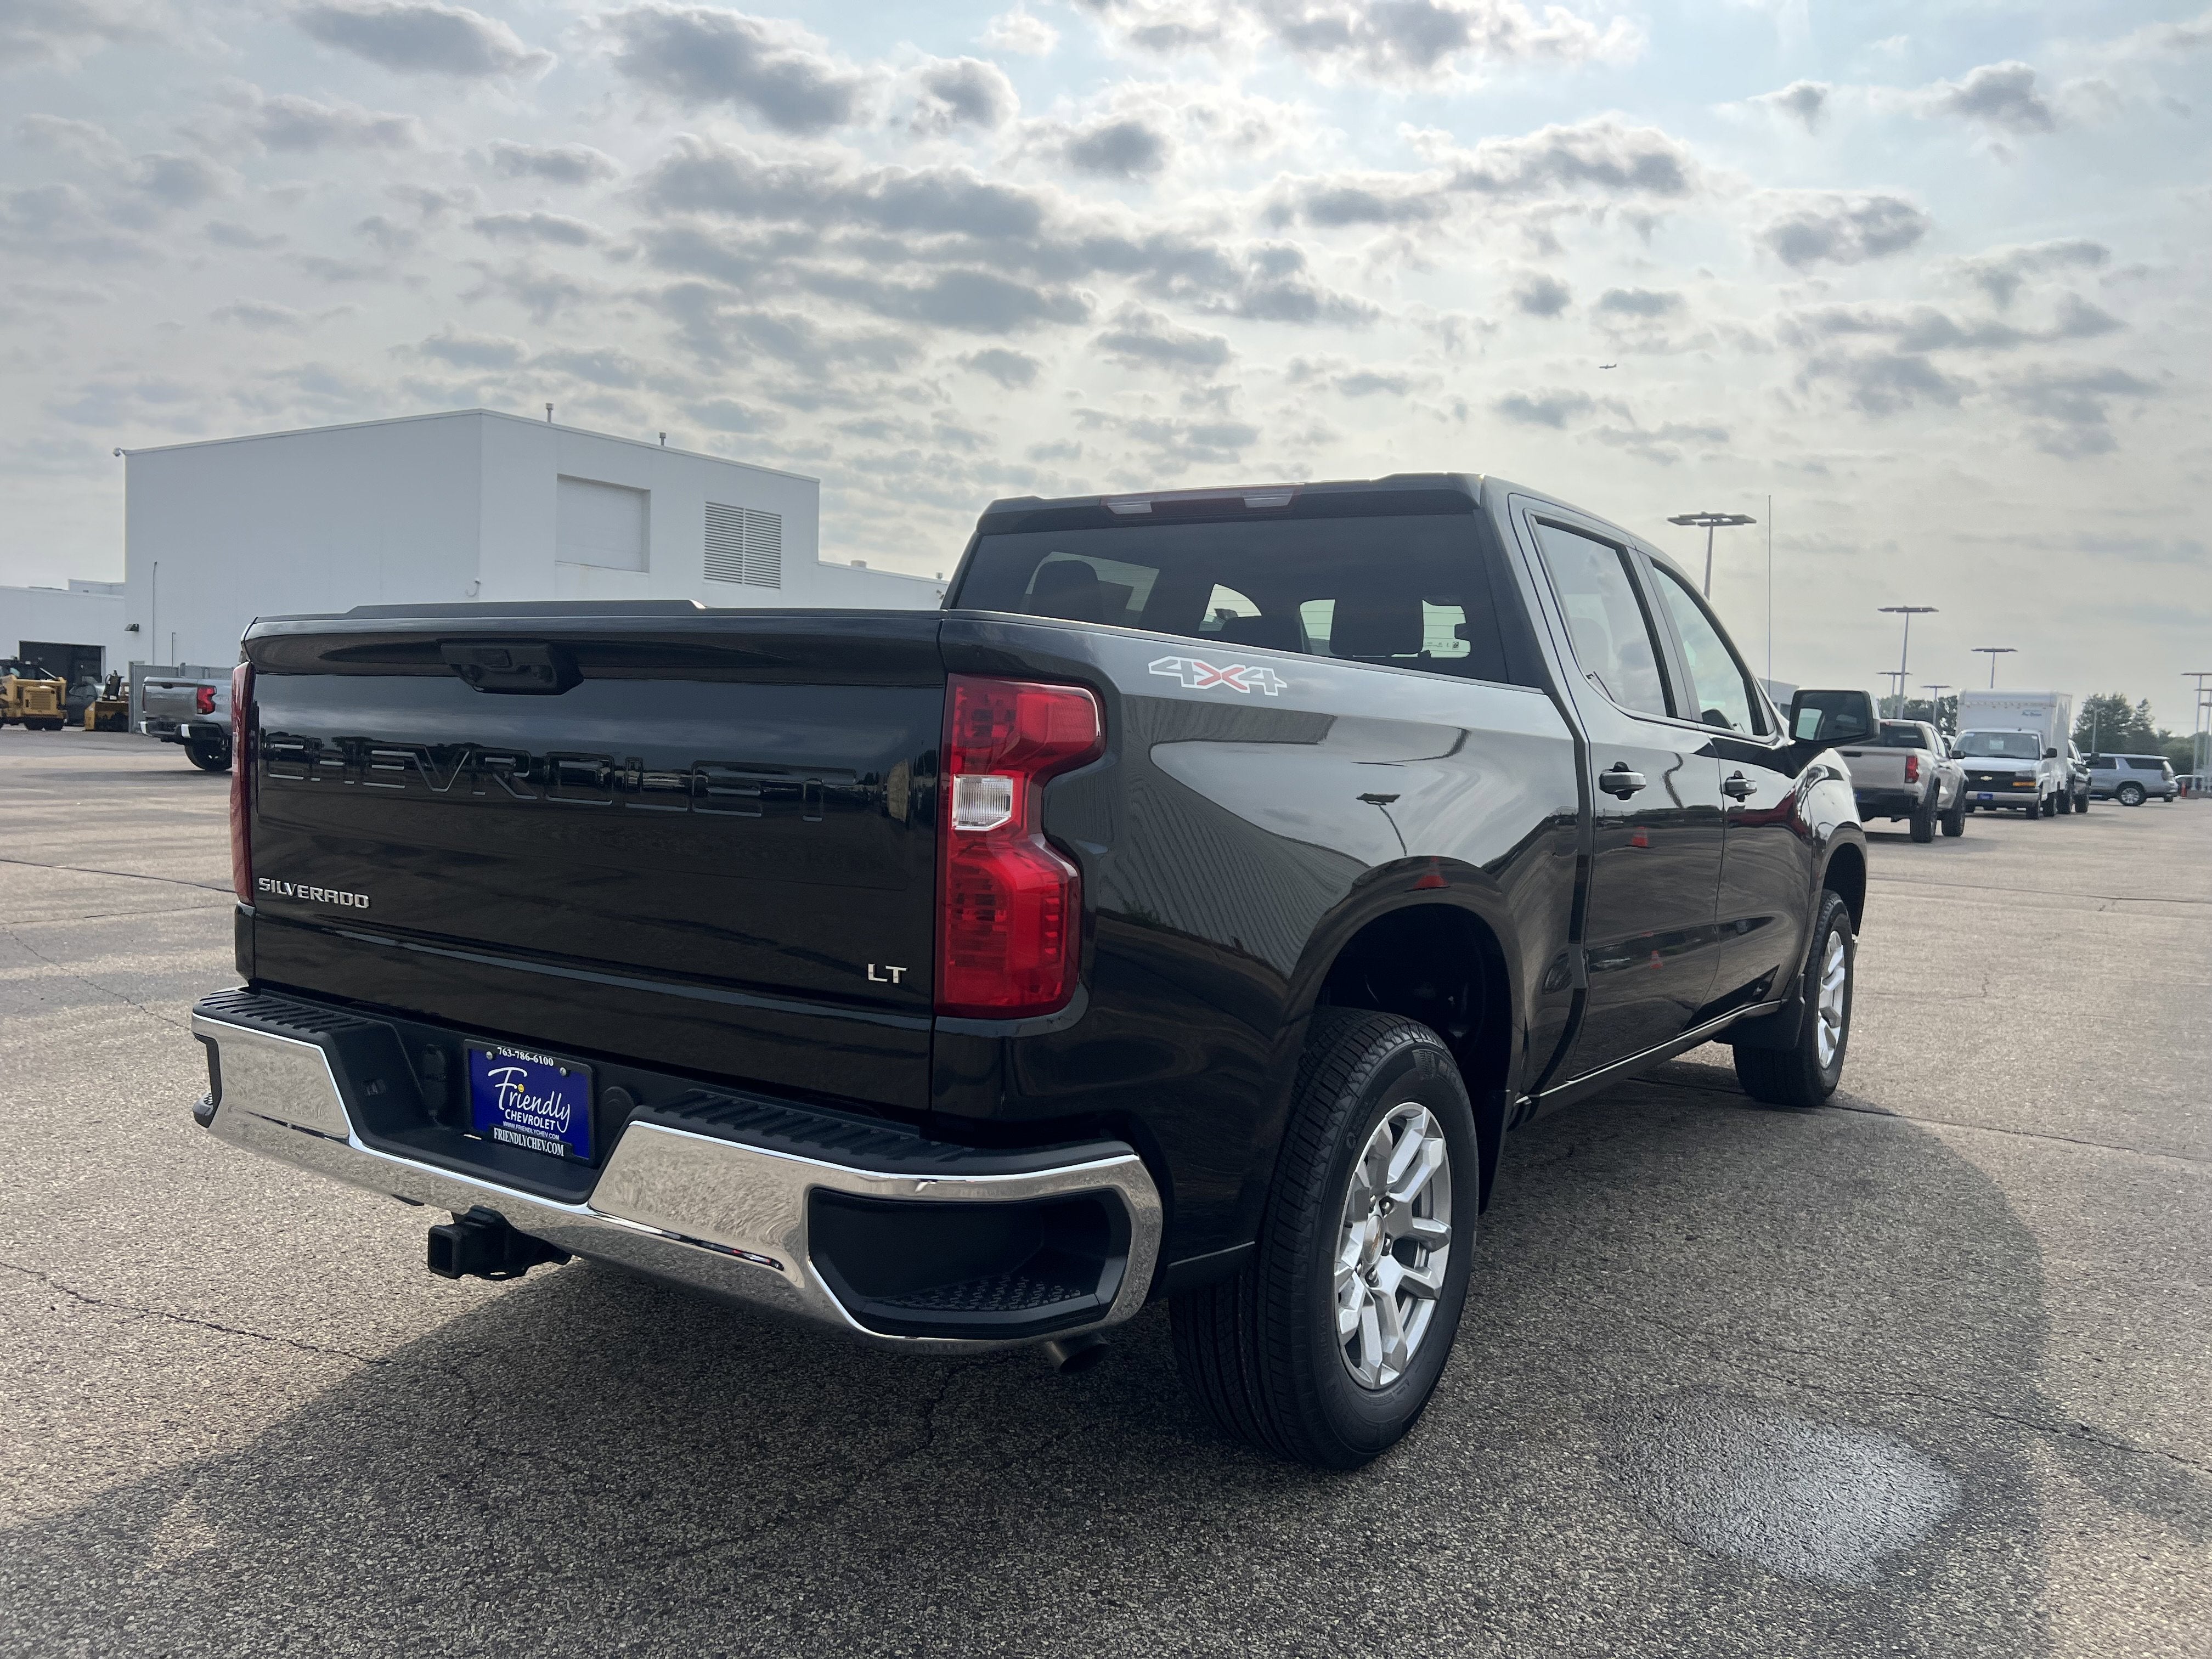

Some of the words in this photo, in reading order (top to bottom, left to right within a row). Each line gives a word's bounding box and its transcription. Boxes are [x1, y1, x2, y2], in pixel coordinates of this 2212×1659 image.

[258, 877, 369, 909] SILVERADO
[868, 963, 907, 983] LT
[497, 1047, 554, 1066] 763-786-6100
[488, 1066, 571, 1133] Friendly
[503, 1121, 560, 1141] WWW.FRIENDLYCHEV.COM
[505, 1109, 556, 1131] CHEVROLET
[493, 1127, 565, 1157] FRIENDLYCHEV.COM
